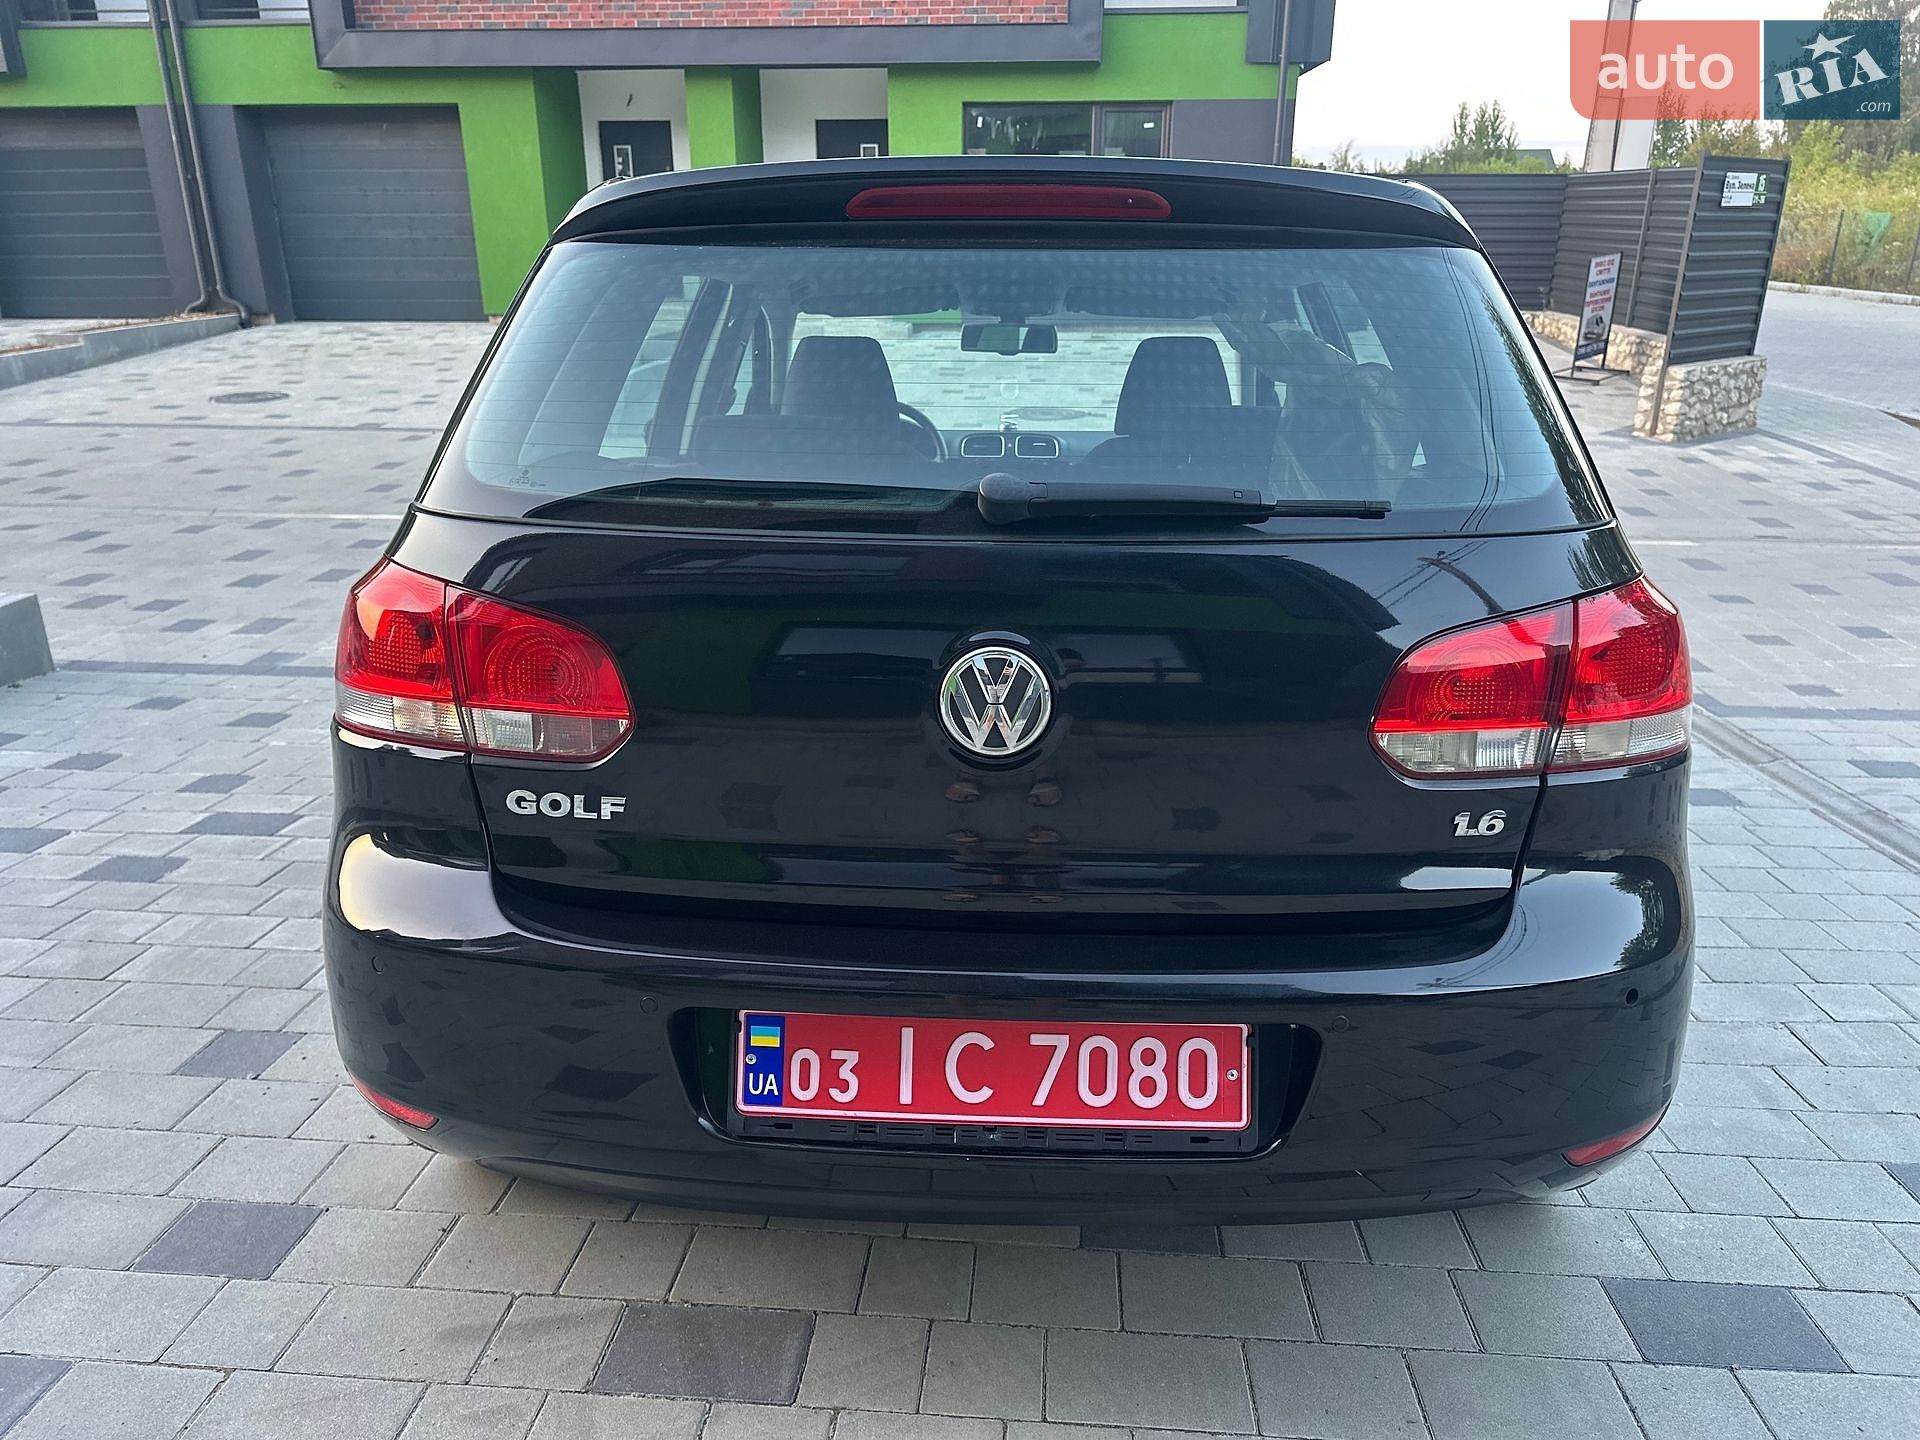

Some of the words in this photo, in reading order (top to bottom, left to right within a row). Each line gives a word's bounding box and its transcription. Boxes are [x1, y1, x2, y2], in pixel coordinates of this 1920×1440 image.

[942, 647, 1050, 755] VW
[506, 789, 626, 820] GOLF
[1454, 810, 1507, 837] 1.6
[748, 1072, 779, 1097] UA
[790, 1048, 860, 1103] 03
[1029, 1033, 1219, 1110] 7080
